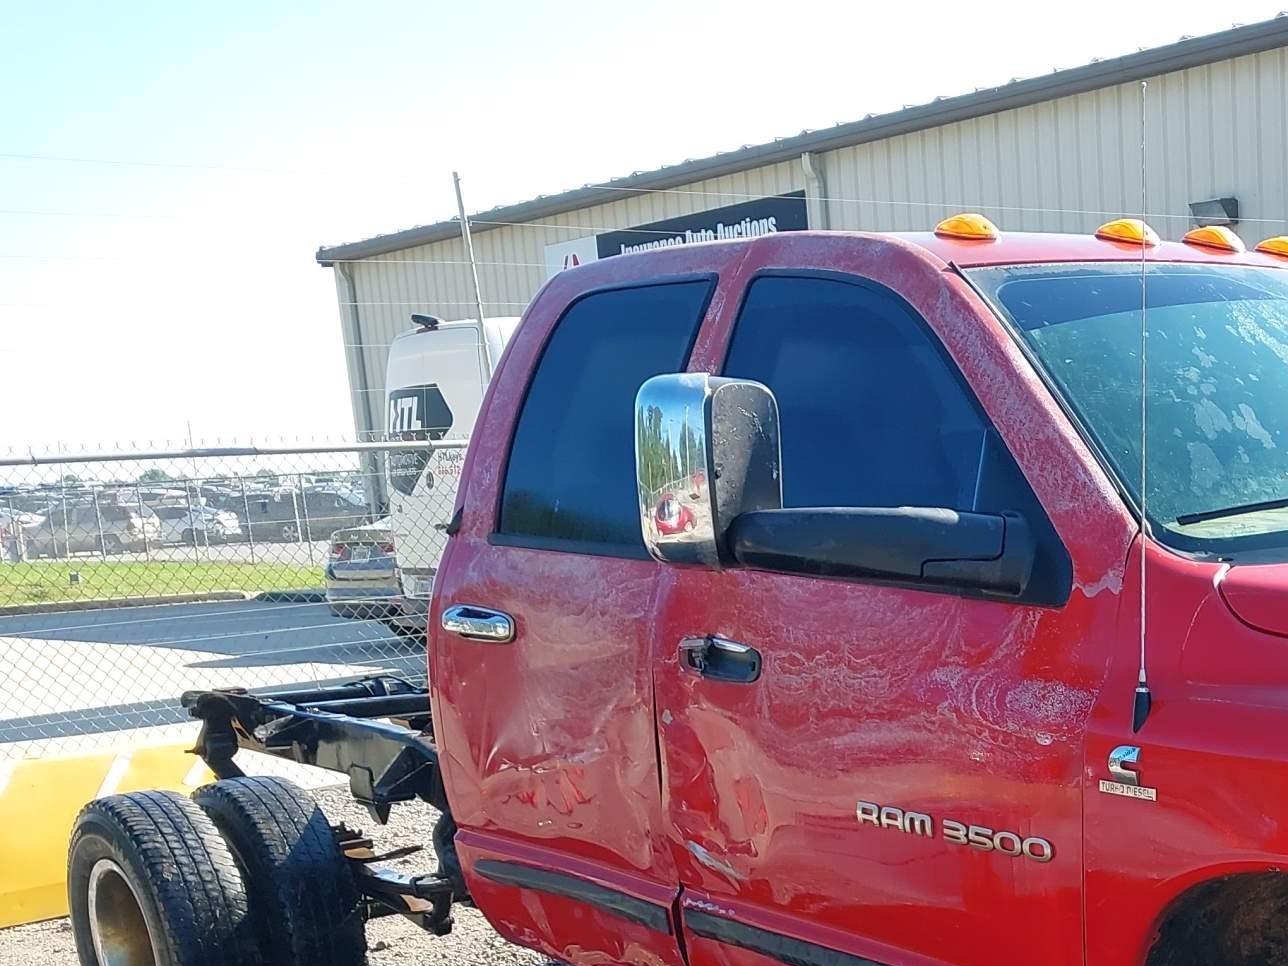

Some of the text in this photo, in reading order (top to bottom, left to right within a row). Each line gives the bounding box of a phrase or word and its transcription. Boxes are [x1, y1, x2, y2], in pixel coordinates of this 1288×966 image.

[685, 229, 715, 244] Auto
[717, 216, 777, 240] Auctions
[856, 800, 1055, 862] RAM 3500
